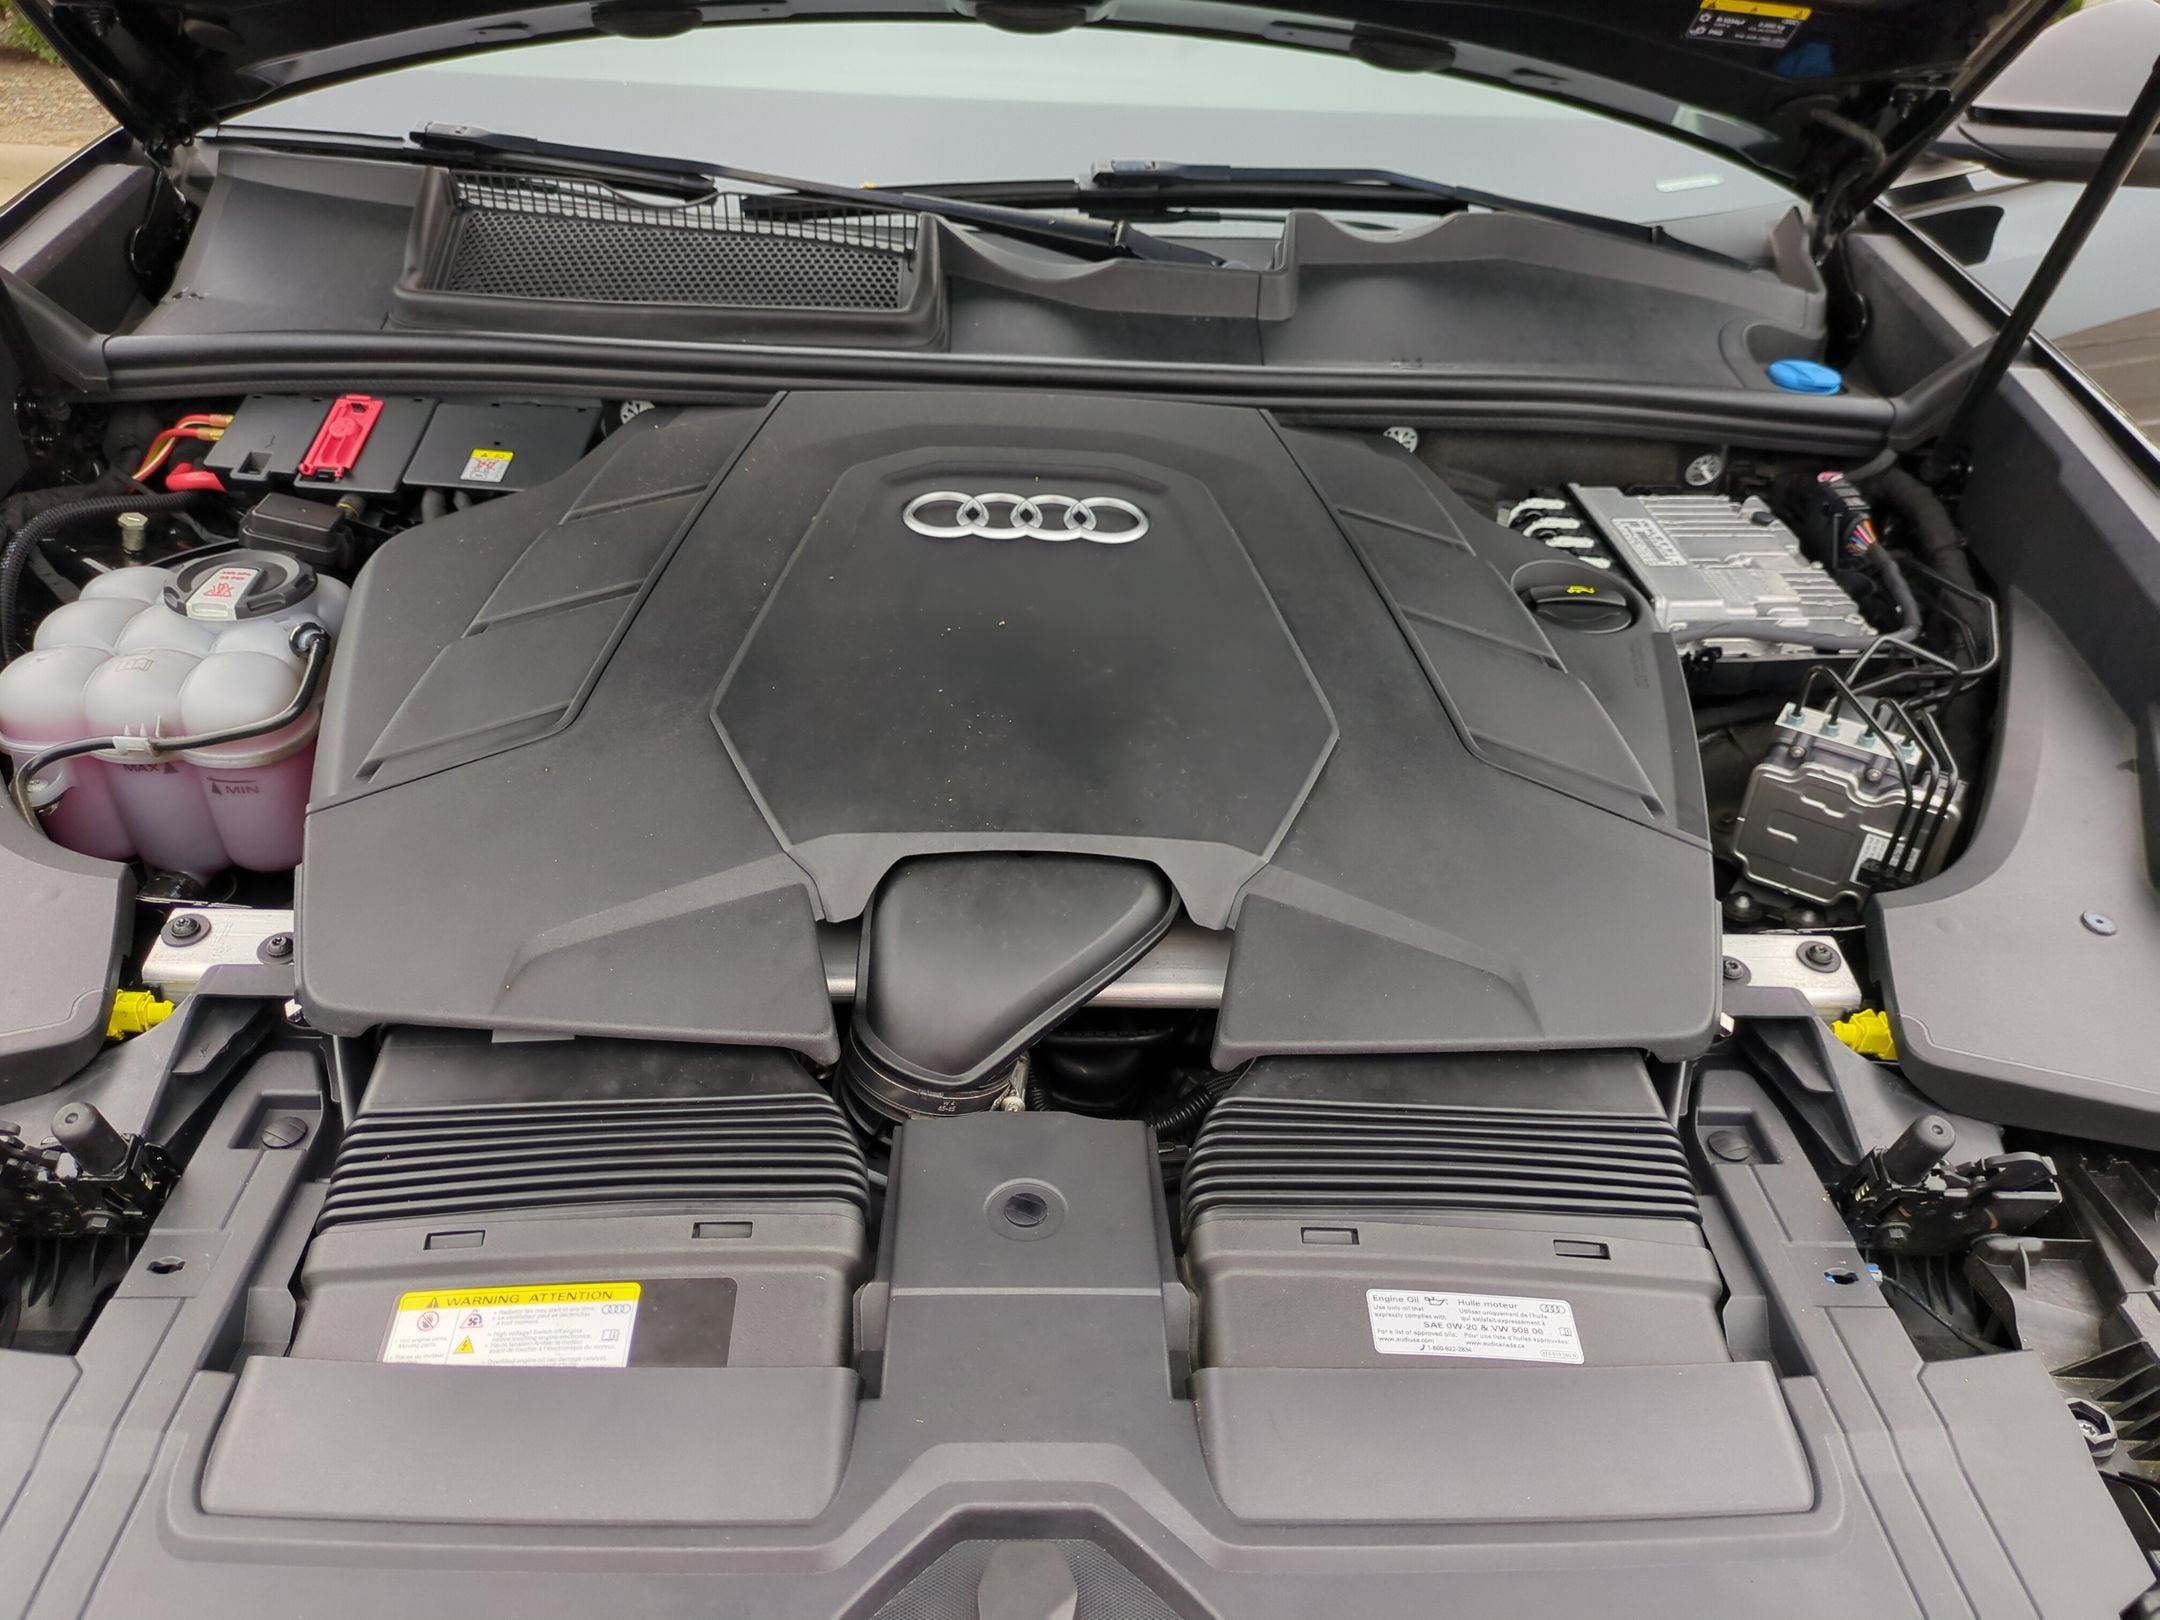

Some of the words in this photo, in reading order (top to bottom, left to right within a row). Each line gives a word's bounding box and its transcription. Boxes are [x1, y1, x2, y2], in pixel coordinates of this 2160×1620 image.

[225, 785, 259, 794] MIN
[447, 1294, 520, 1307] WARNING
[529, 1291, 614, 1303] ATTENTION
[1373, 1295, 1404, 1303] Engine
[1484, 1301, 1518, 1309] moteur
[1446, 1322, 1478, 1331] 0W-20
[1532, 1327, 1544, 1335] 00
